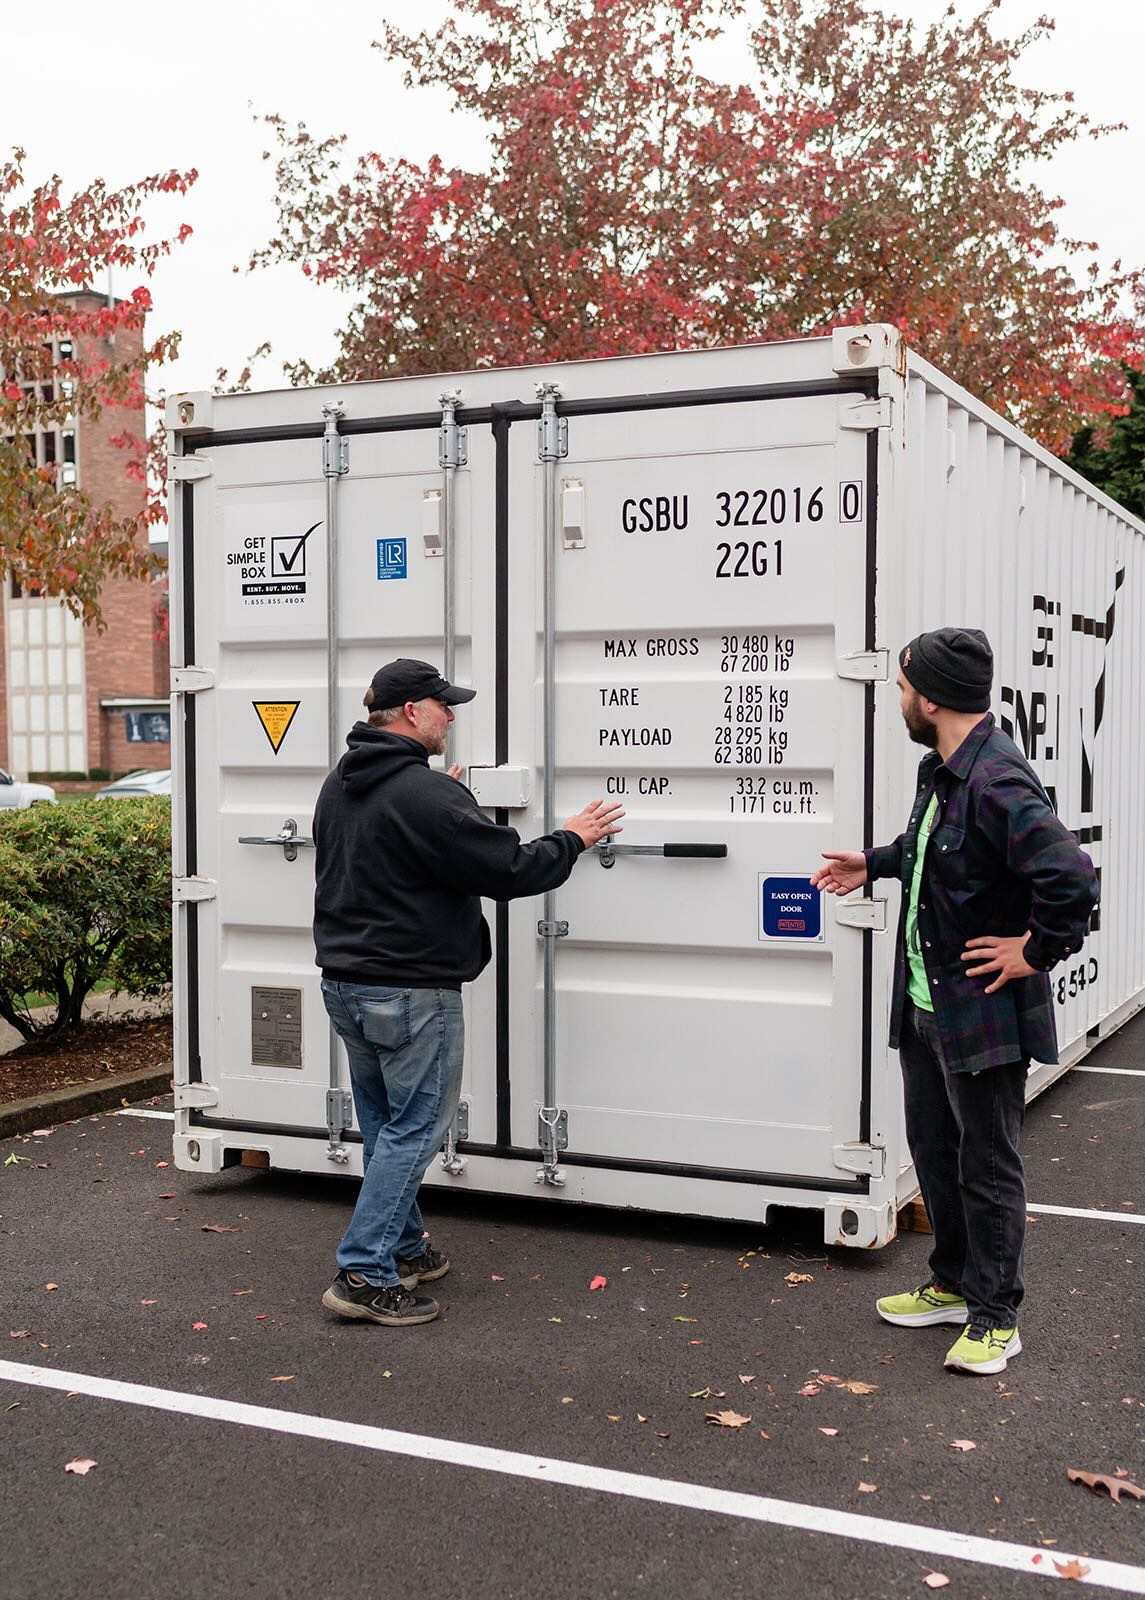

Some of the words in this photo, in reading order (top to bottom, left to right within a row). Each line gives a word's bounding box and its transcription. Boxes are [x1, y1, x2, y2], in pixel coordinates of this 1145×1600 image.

[623, 495, 687, 533] GSBU
[716, 487, 823, 526] 322016
[843, 485, 859, 519] 0
[245, 537, 265, 549] GET
[227, 552, 265, 564] SIMPLE
[716, 540, 781, 577] 22G1
[242, 567, 265, 578] BOX
[281, 584, 302, 592] MOVE.
[605, 640, 636, 657] MAX
[647, 638, 698, 656] GROSS
[776, 635, 793, 658] kg
[775, 655, 790, 671] lb
[600, 688, 639, 706] TARE
[770, 686, 788, 709] kg
[770, 704, 785, 722] lb
[600, 729, 671, 745] PAYLOAD
[769, 727, 787, 750] kg
[769, 746, 784, 764] lb
[607, 777, 629, 794] CU.
[639, 777, 671, 794] CAP.
[737, 777, 765, 794] 33.2
[773, 782, 818, 794] cu.m.
[773, 797, 815, 813] cu.ft.
[790, 892, 812, 900] OPEN
